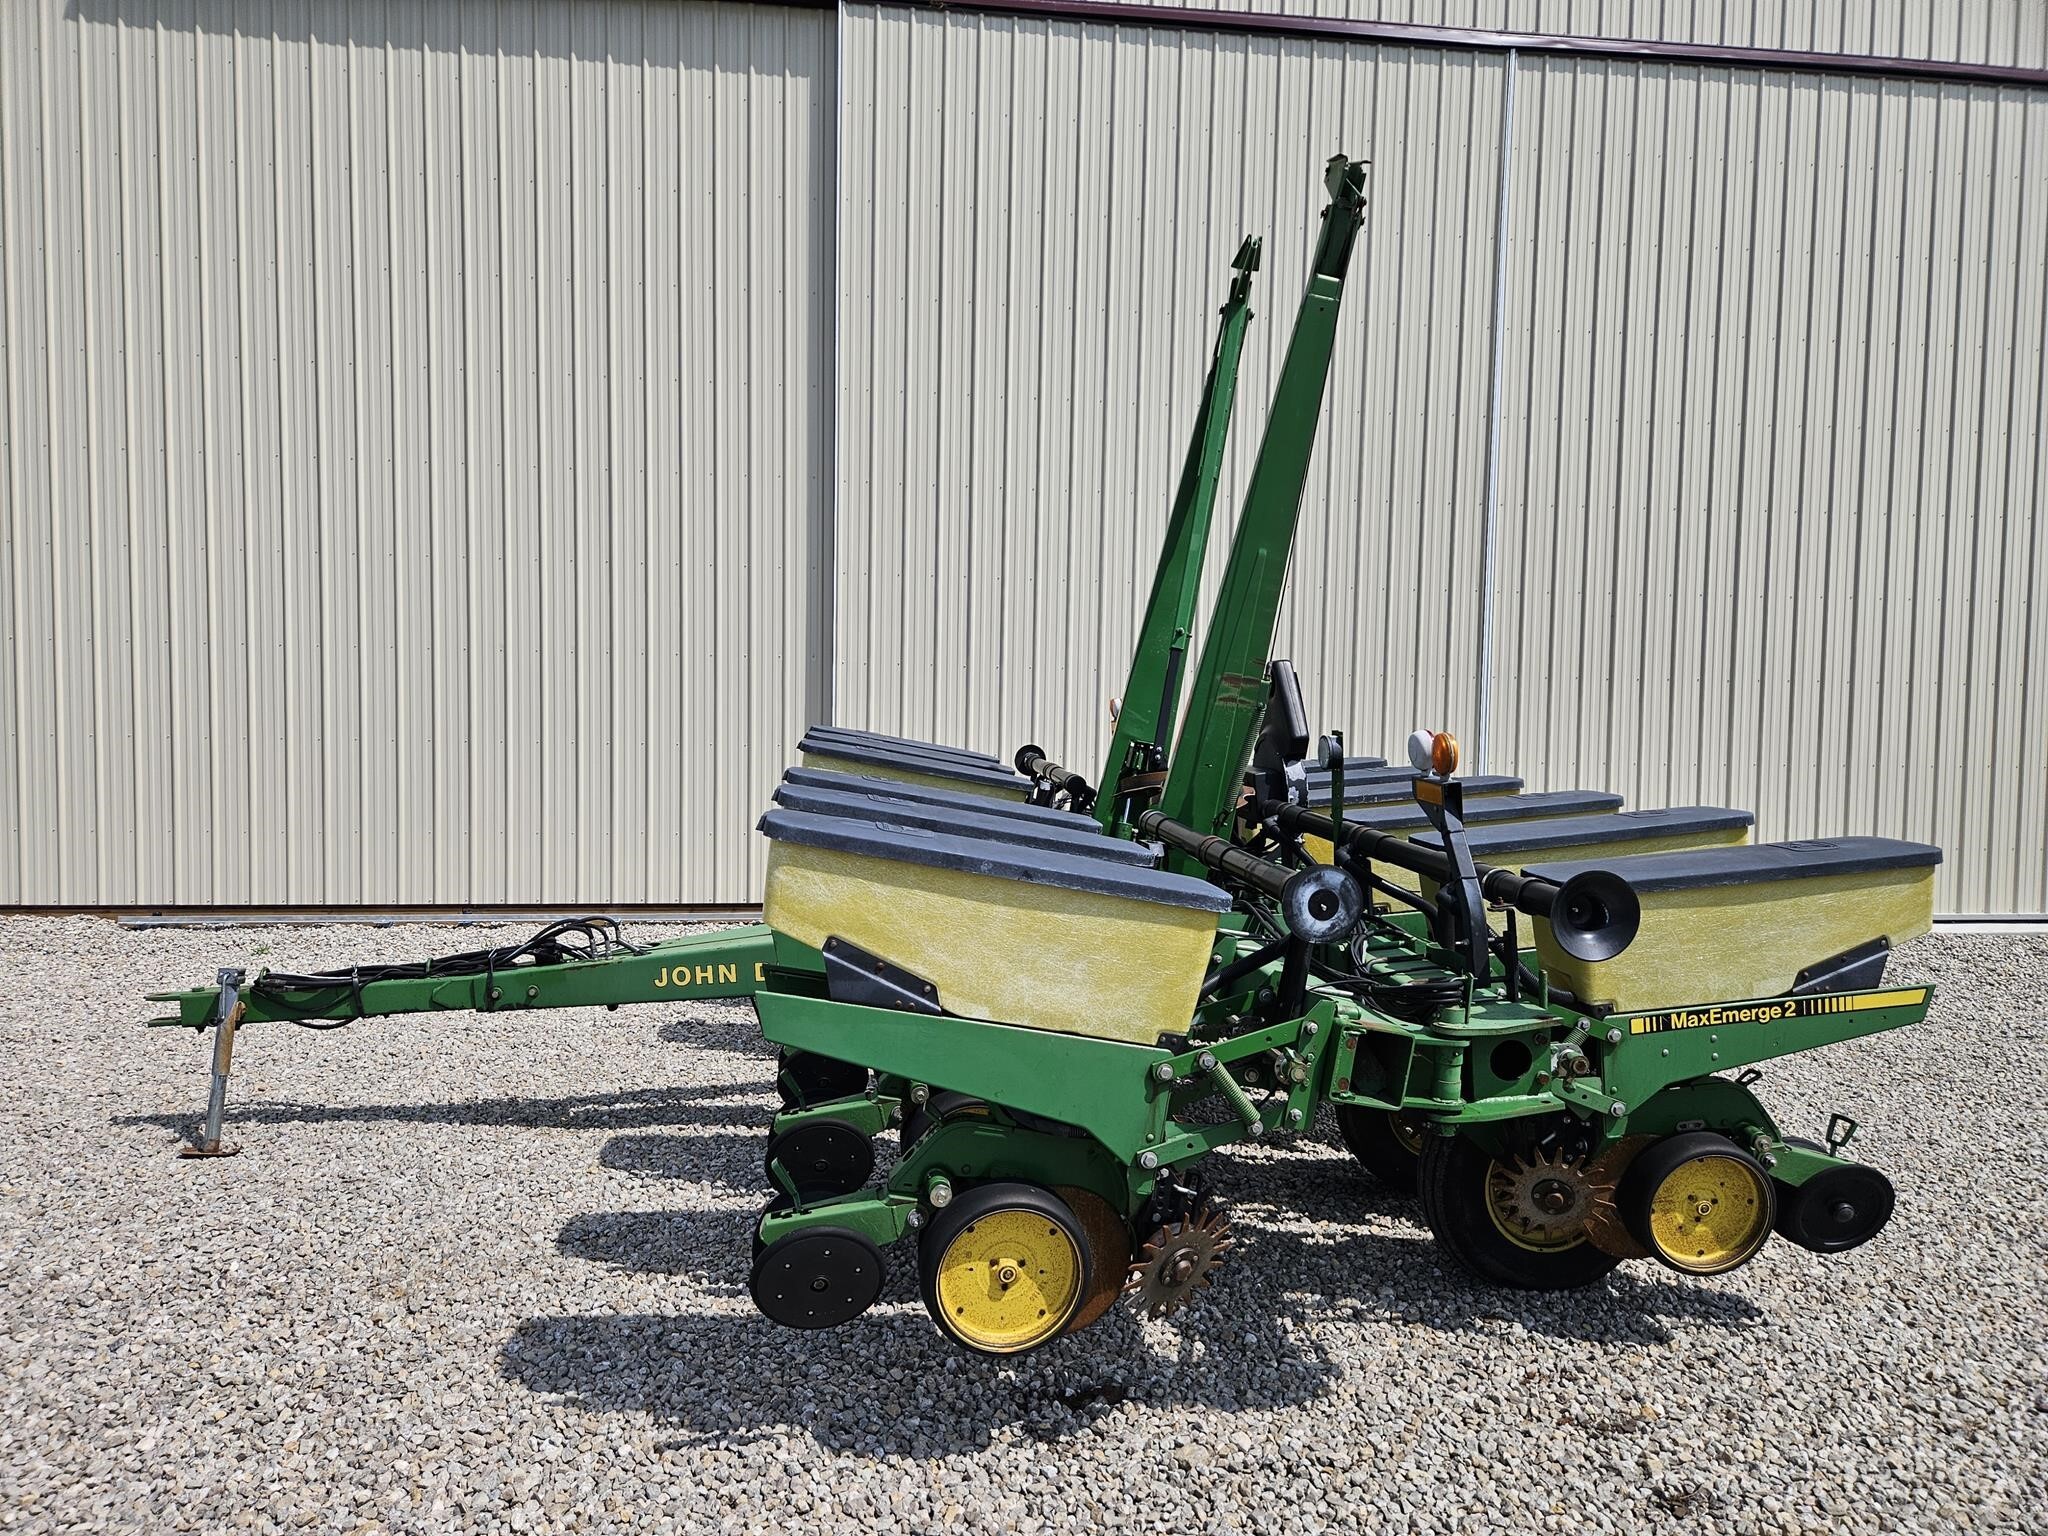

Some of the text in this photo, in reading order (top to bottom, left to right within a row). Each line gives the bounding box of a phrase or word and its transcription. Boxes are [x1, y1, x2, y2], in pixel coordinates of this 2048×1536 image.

[654, 963, 737, 987] JOHN
[1670, 1001, 1797, 1029] MaxEmerge 2
